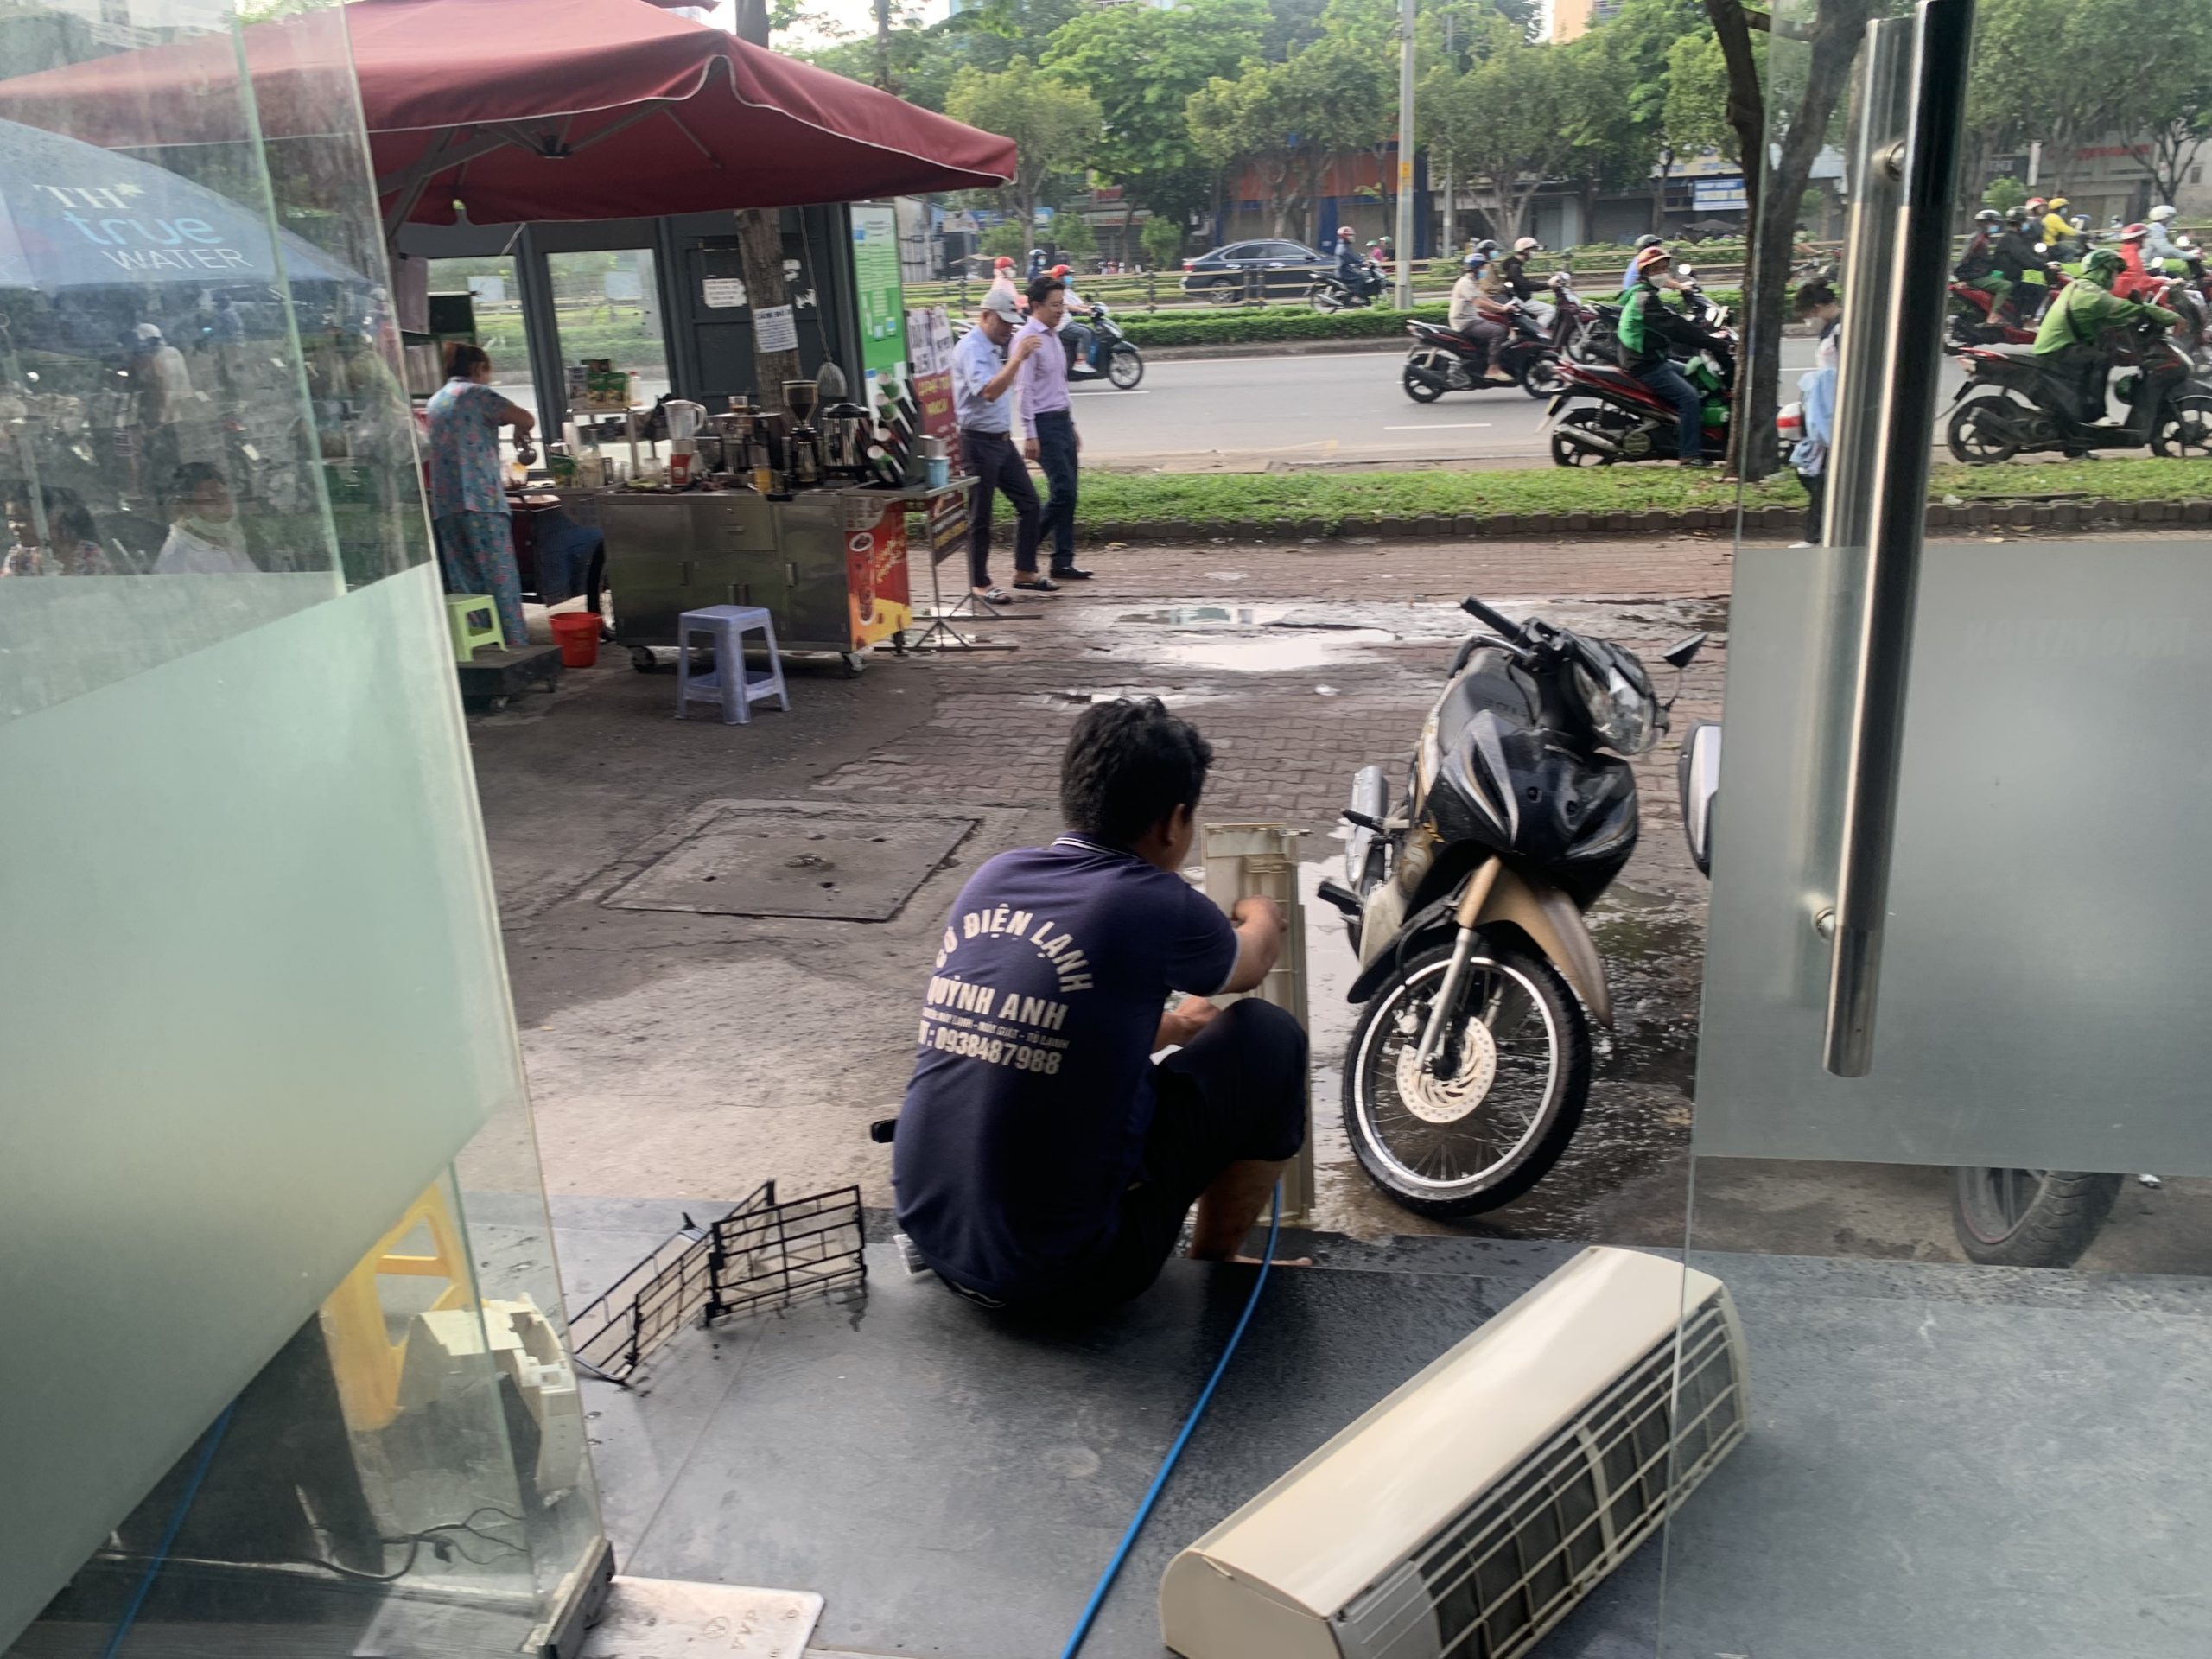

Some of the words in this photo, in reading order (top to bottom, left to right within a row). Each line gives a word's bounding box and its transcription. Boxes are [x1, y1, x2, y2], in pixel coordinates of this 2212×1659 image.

[63, 210, 224, 245] true
[100, 248, 254, 270] WATER
[963, 903, 1033, 940] ĐIỆN
[1029, 921, 1094, 993] LẠNH
[998, 993, 1069, 1031] ANH
